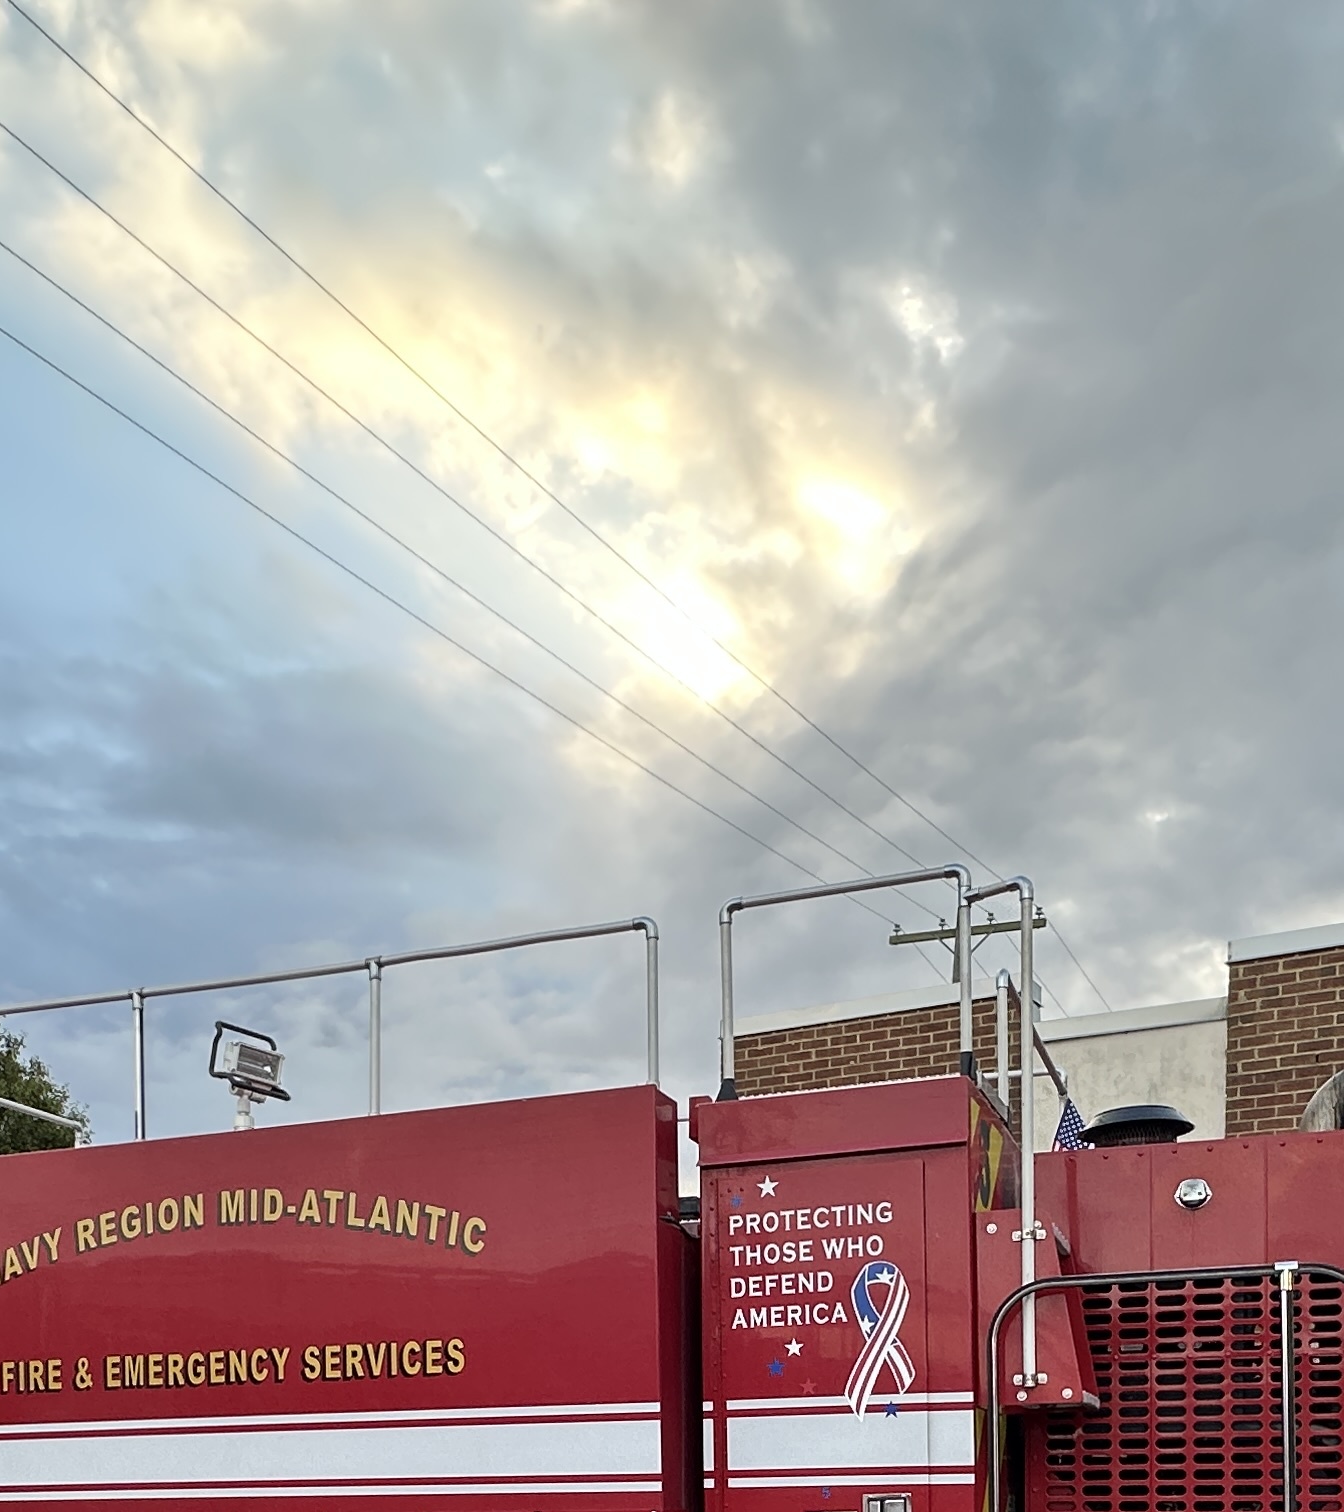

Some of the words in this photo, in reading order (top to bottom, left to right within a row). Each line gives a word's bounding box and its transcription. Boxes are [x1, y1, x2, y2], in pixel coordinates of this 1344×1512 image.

[75, 1193, 204, 1253] REGION
[218, 1188, 487, 1254] MID-ATLANTIC
[728, 1201, 893, 1236] PROTECTING
[729, 1240, 814, 1267] THOSE
[821, 1234, 884, 1260] WHO
[730, 1271, 834, 1298] DEFEND
[731, 1302, 848, 1330] AMERICA
[0, 1359, 63, 1393] FIRE
[74, 1357, 94, 1390] &
[105, 1347, 290, 1389] EMERGENCY
[303, 1338, 466, 1380] SERVICES
